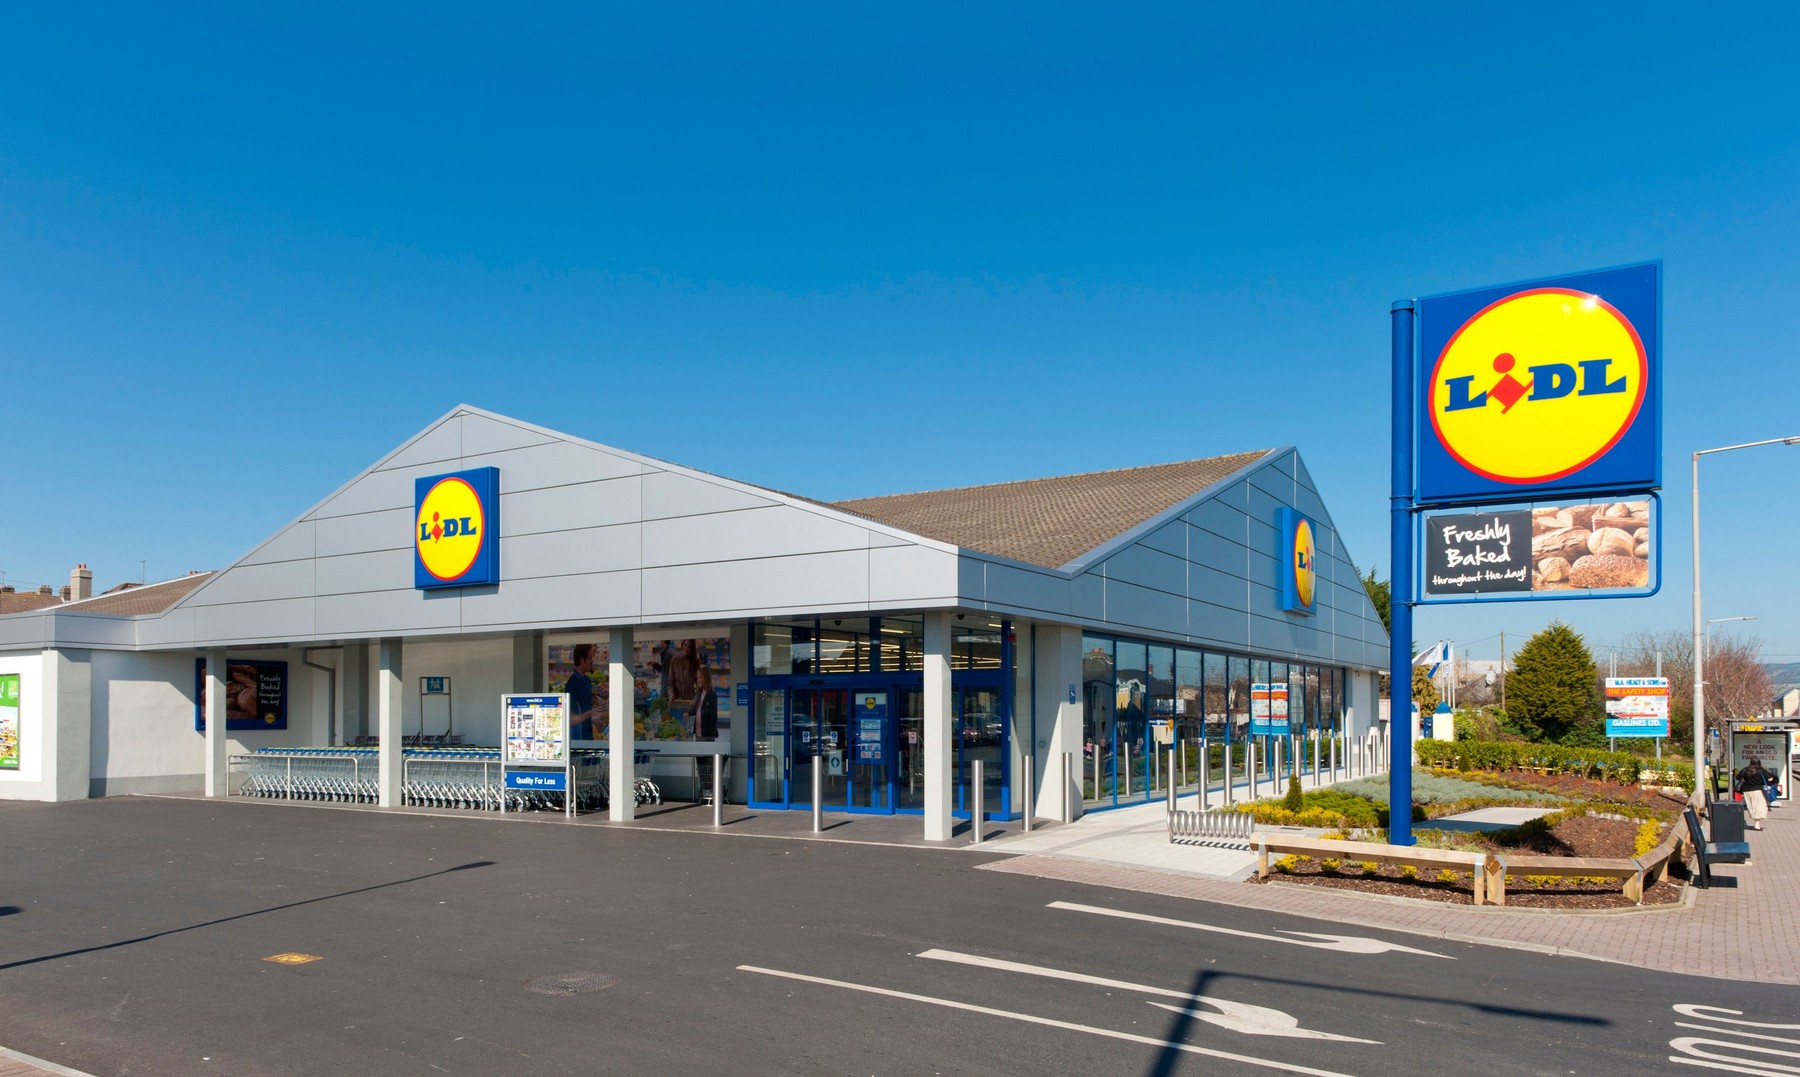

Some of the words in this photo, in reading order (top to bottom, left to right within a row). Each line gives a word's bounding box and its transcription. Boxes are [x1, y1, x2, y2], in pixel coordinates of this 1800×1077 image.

[1442, 517, 1511, 546] Freshly
[1445, 545, 1511, 567] Baked
[1432, 571, 1482, 586] throughout
[1484, 570, 1503, 580] the
[1504, 566, 1527, 582] day!
[516, 777, 533, 785] Quality
